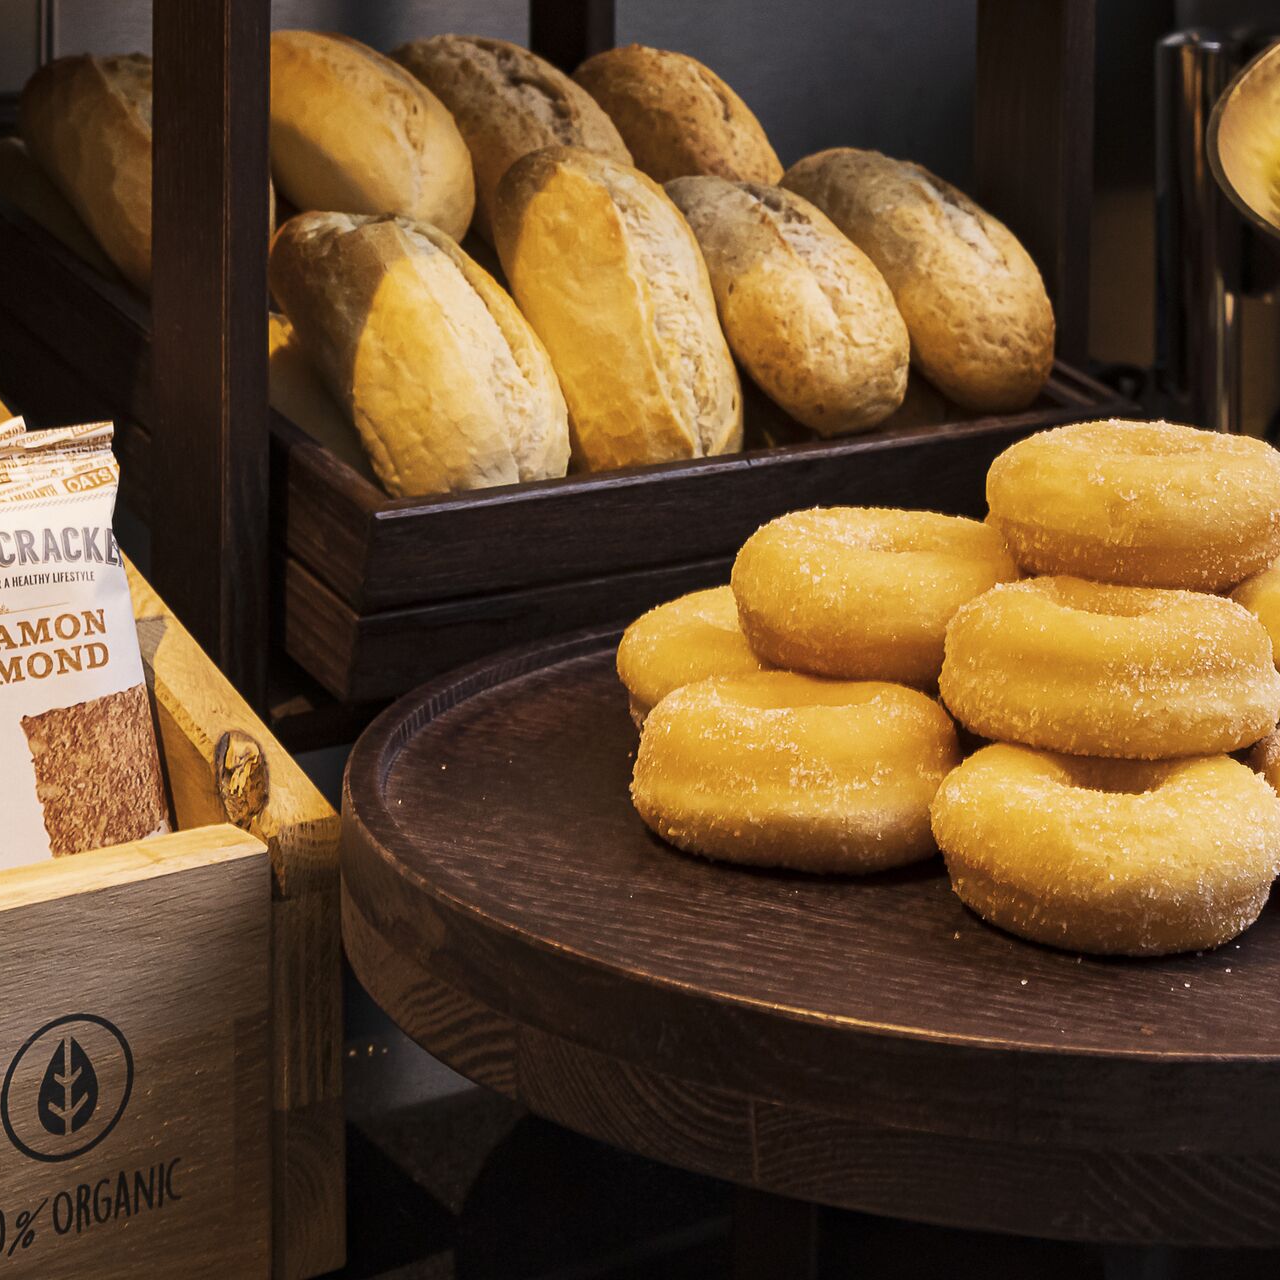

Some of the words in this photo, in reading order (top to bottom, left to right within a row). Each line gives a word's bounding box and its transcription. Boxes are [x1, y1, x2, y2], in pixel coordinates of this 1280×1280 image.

[63, 467, 116, 494] OATS
[4, 577, 11, 589] A
[12, 572, 51, 588] HEALTHY
[52, 570, 96, 584] LIFESTYLE
[51, 1157, 184, 1237] ORGANIC
